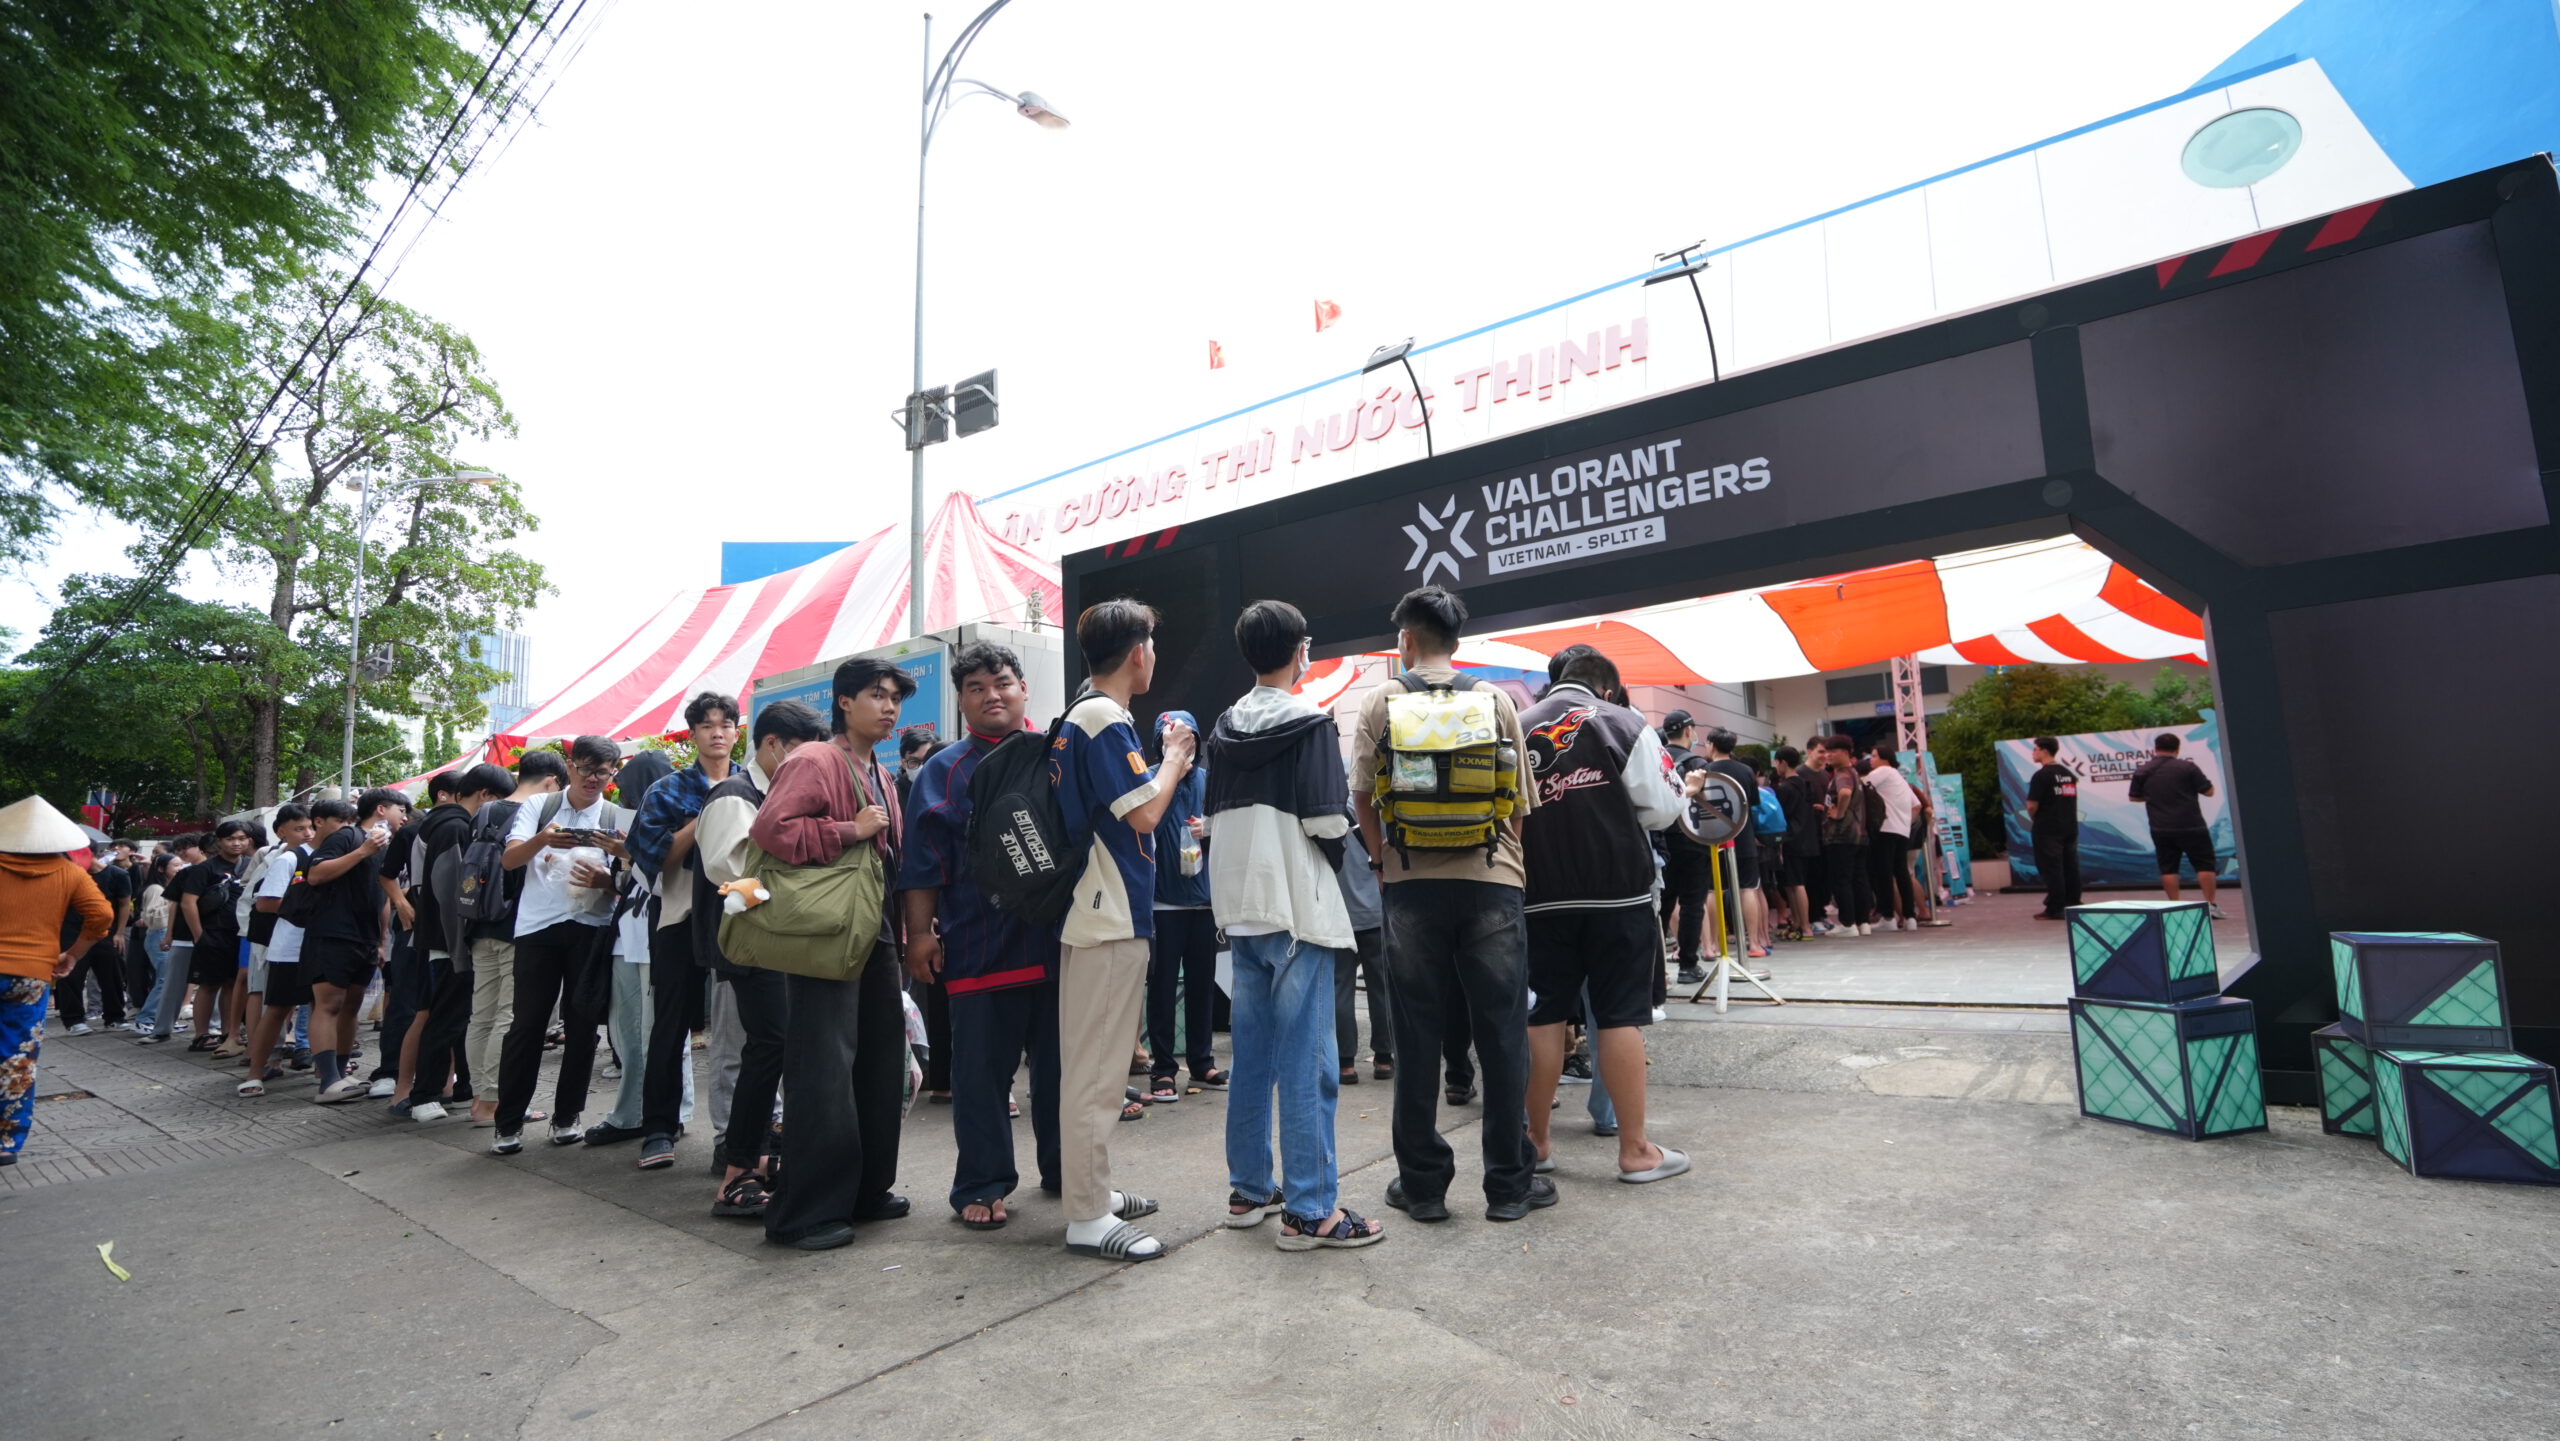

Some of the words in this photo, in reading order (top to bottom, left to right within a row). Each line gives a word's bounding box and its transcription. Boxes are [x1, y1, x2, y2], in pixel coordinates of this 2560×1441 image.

[1001, 509, 1047, 546] ÂN
[1054, 464, 1187, 534] CƯỜNG
[1201, 427, 1276, 491] THÌ
[1291, 385, 1435, 464] NƯỚC
[1453, 317, 1648, 413] THỊNH
[1481, 438, 1682, 513] VALORANT
[1485, 456, 1772, 546] CHALLENGERS
[1498, 541, 1571, 567] VIETNAM
[1588, 528, 1639, 550] SPLIT
[1644, 525, 1654, 539] 2
[1544, 766, 1605, 801] System
[2087, 749, 2156, 763] VALORAN
